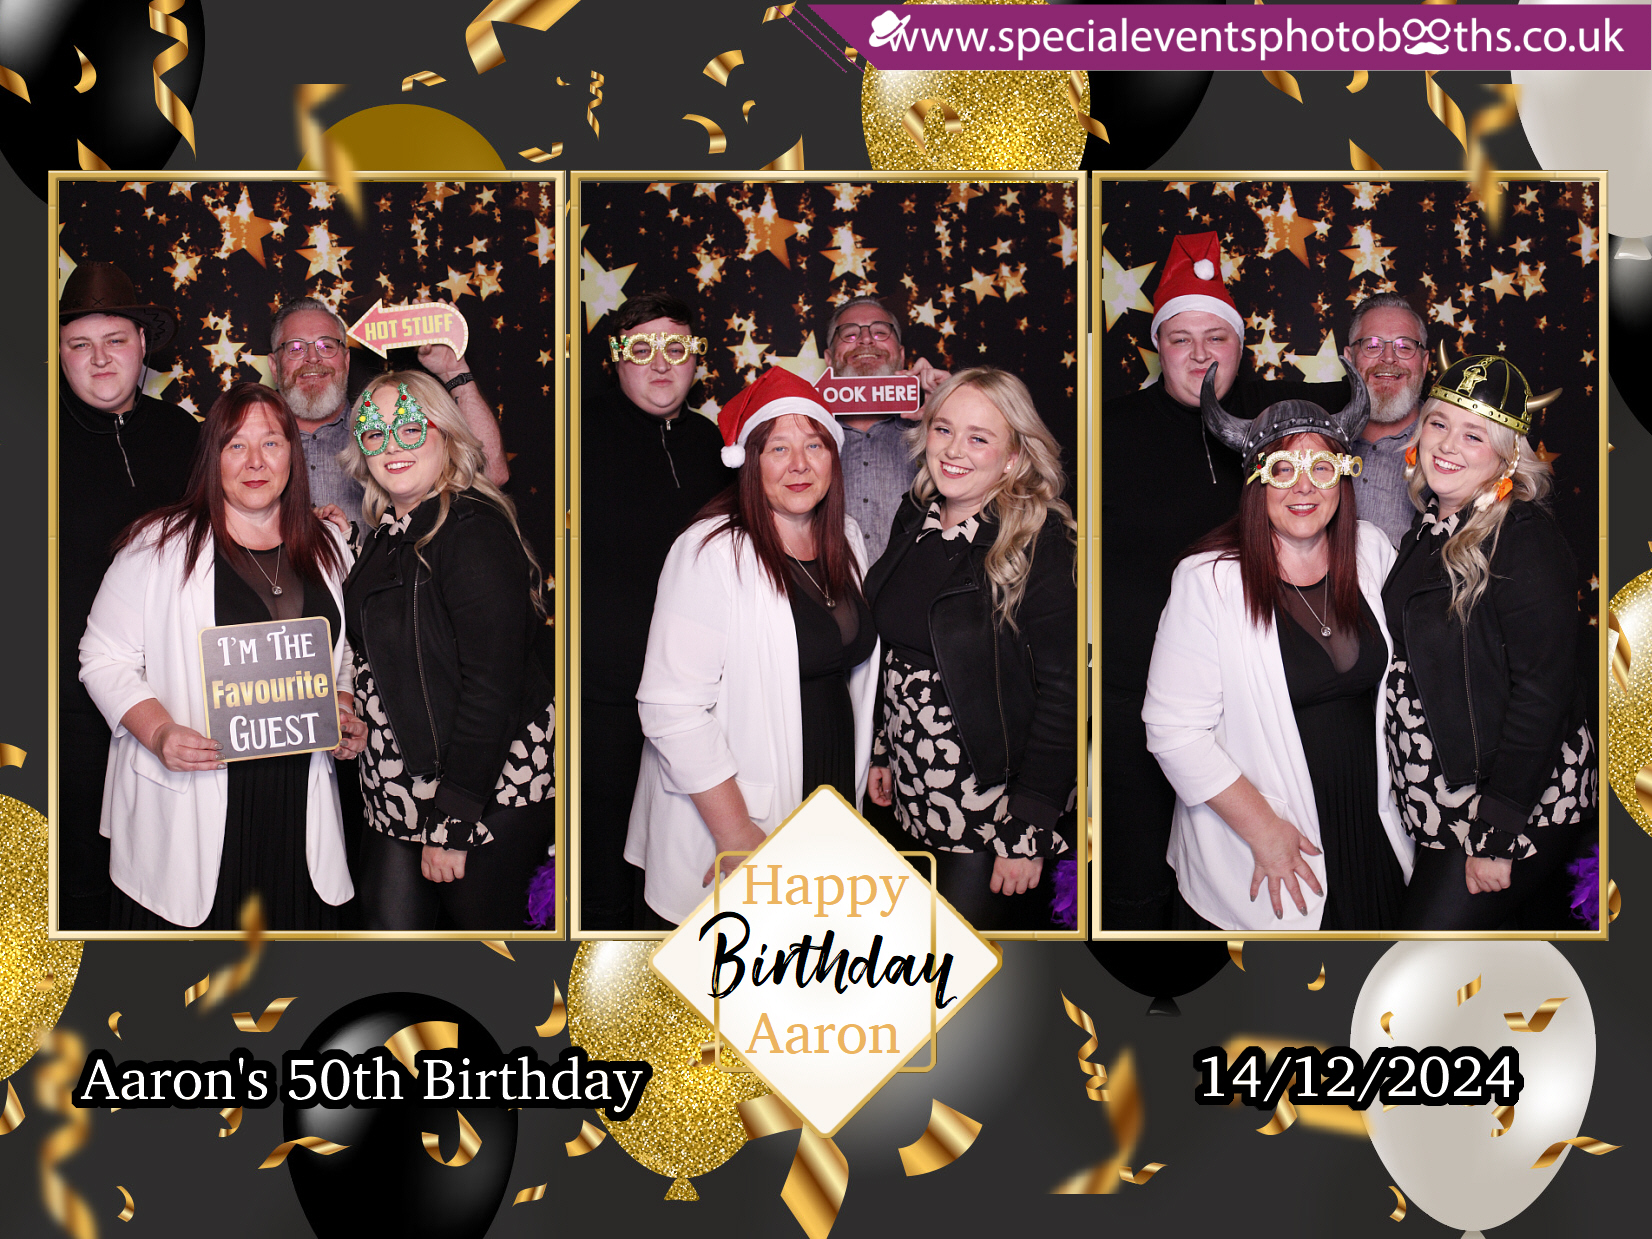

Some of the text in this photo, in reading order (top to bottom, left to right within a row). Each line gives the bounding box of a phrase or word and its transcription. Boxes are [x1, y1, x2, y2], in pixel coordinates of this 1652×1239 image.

[364, 313, 453, 342] HOT STUFF
[815, 384, 917, 403] OOK HERE
[217, 625, 316, 667] I'M THE
[211, 670, 330, 710] Favourite
[229, 712, 320, 752] GUEST
